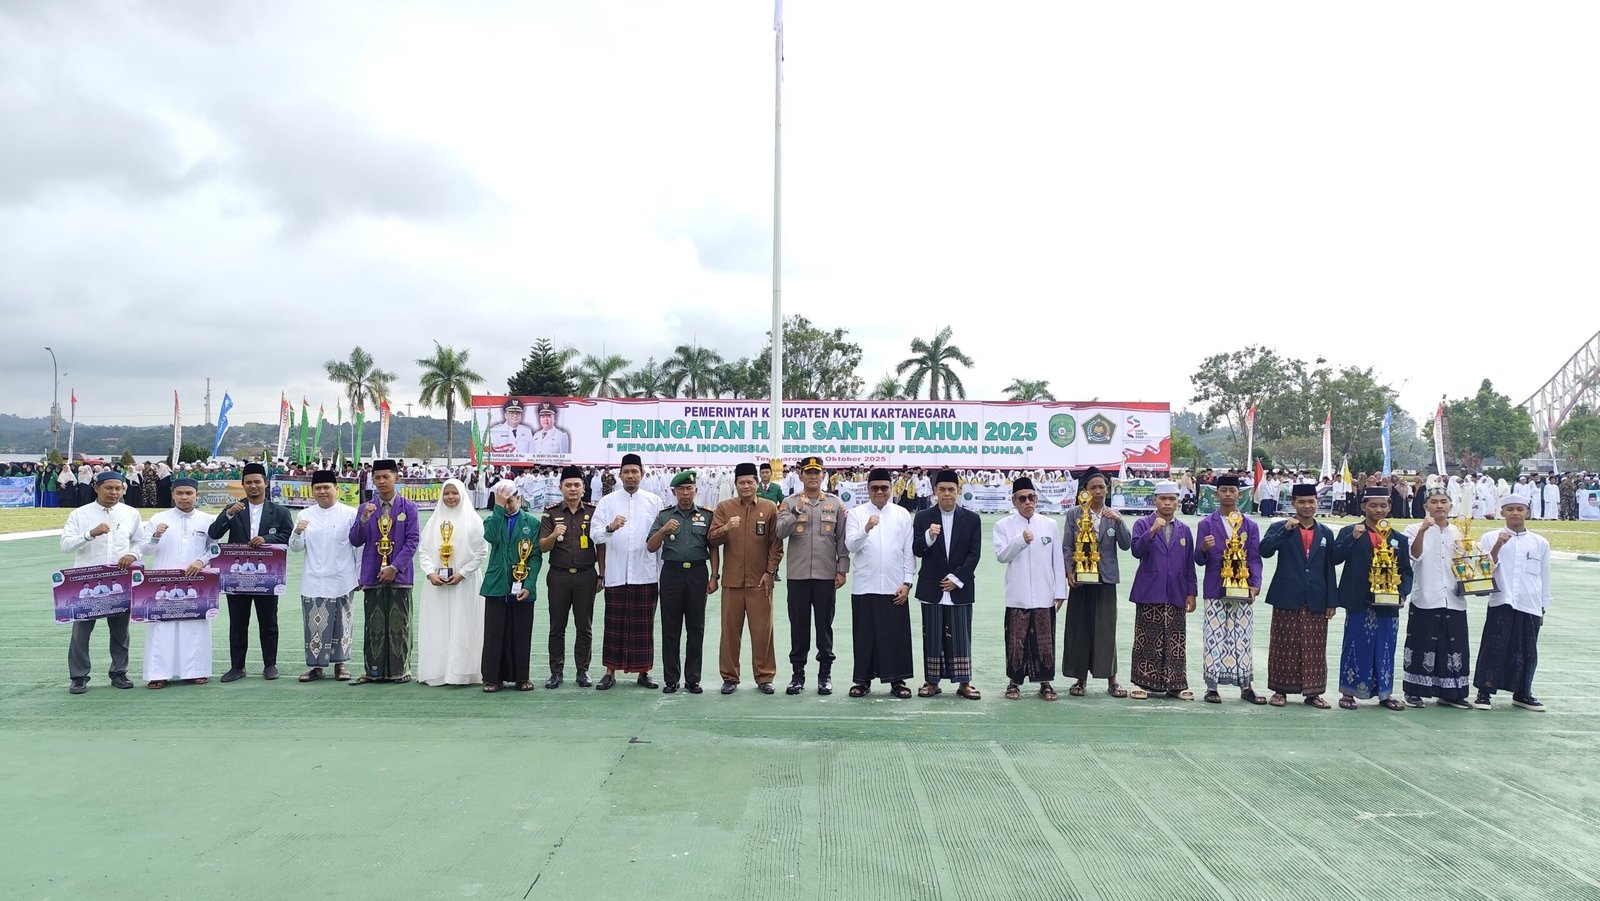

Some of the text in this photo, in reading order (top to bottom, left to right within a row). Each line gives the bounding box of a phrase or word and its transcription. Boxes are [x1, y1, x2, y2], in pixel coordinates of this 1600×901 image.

[684, 406, 956, 419] PEMERINTAH KUPATEN KUTAI KARTANEGARA
[602, 419, 1038, 442] PERINGATAN HRI SANTRI TAHUN 2025
[617, 443, 693, 452] MENGAWAL
[697, 443, 770, 453] INDONESIA
[840, 445, 895, 454] MENUJU
[899, 445, 978, 455] PERADABAN
[982, 445, 1024, 455] DUNIA
